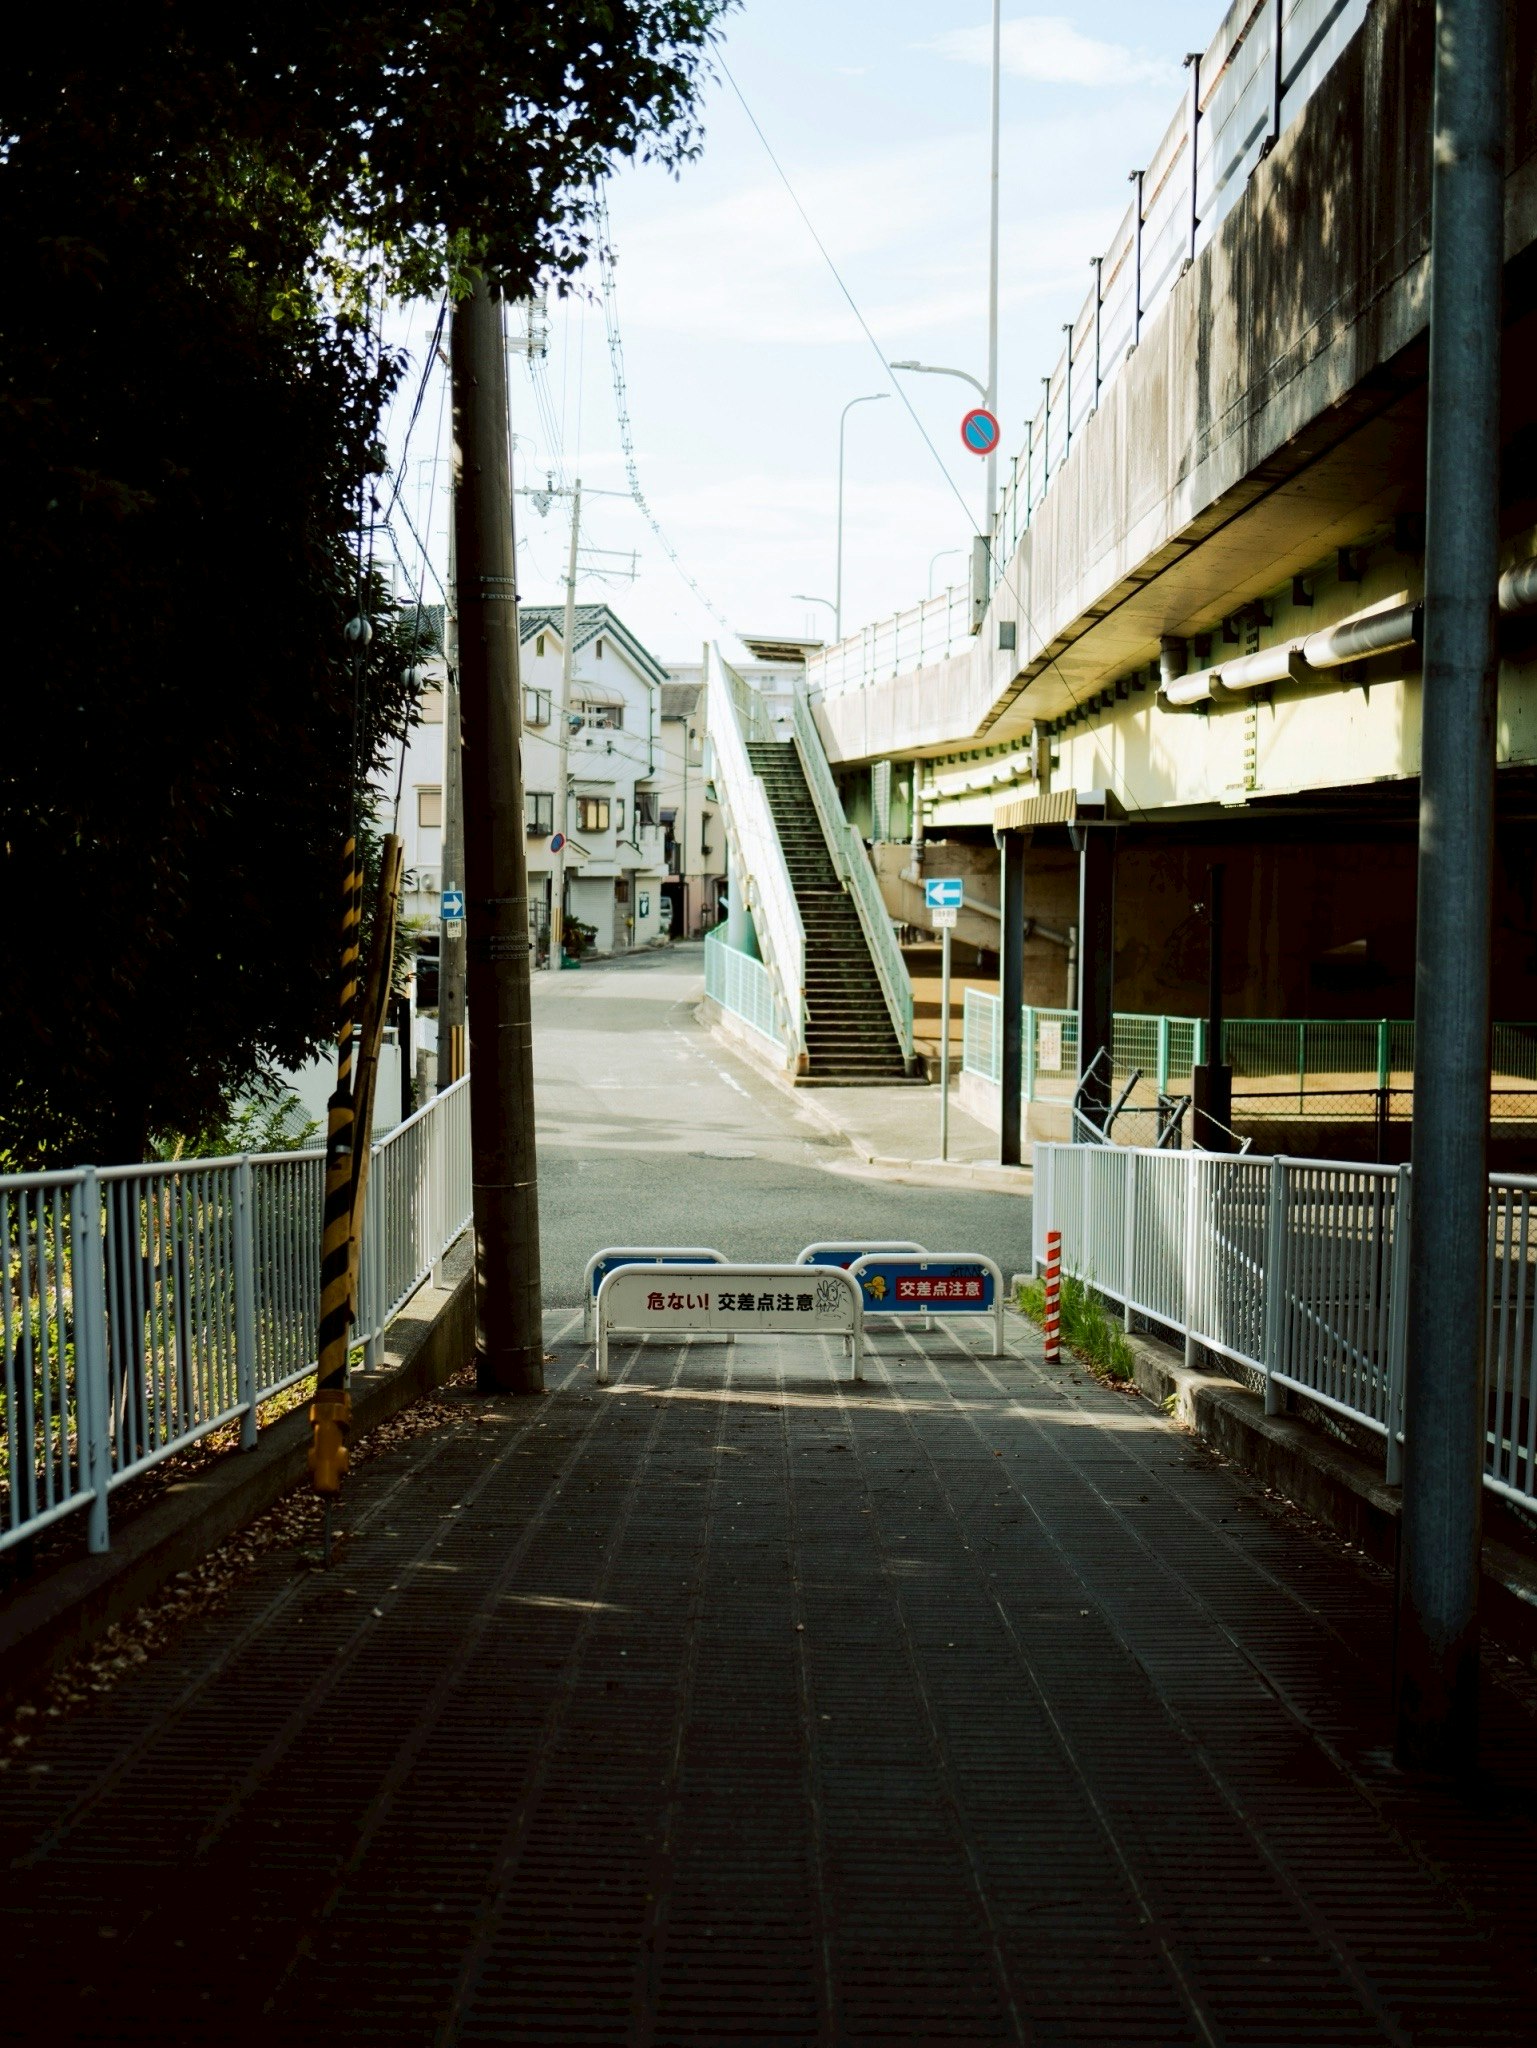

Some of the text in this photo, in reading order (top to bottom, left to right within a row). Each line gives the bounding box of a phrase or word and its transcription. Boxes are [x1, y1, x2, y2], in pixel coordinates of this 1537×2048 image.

[900, 1281, 980, 1297] 交差点注意
[718, 1292, 814, 1311] 交差点注意
